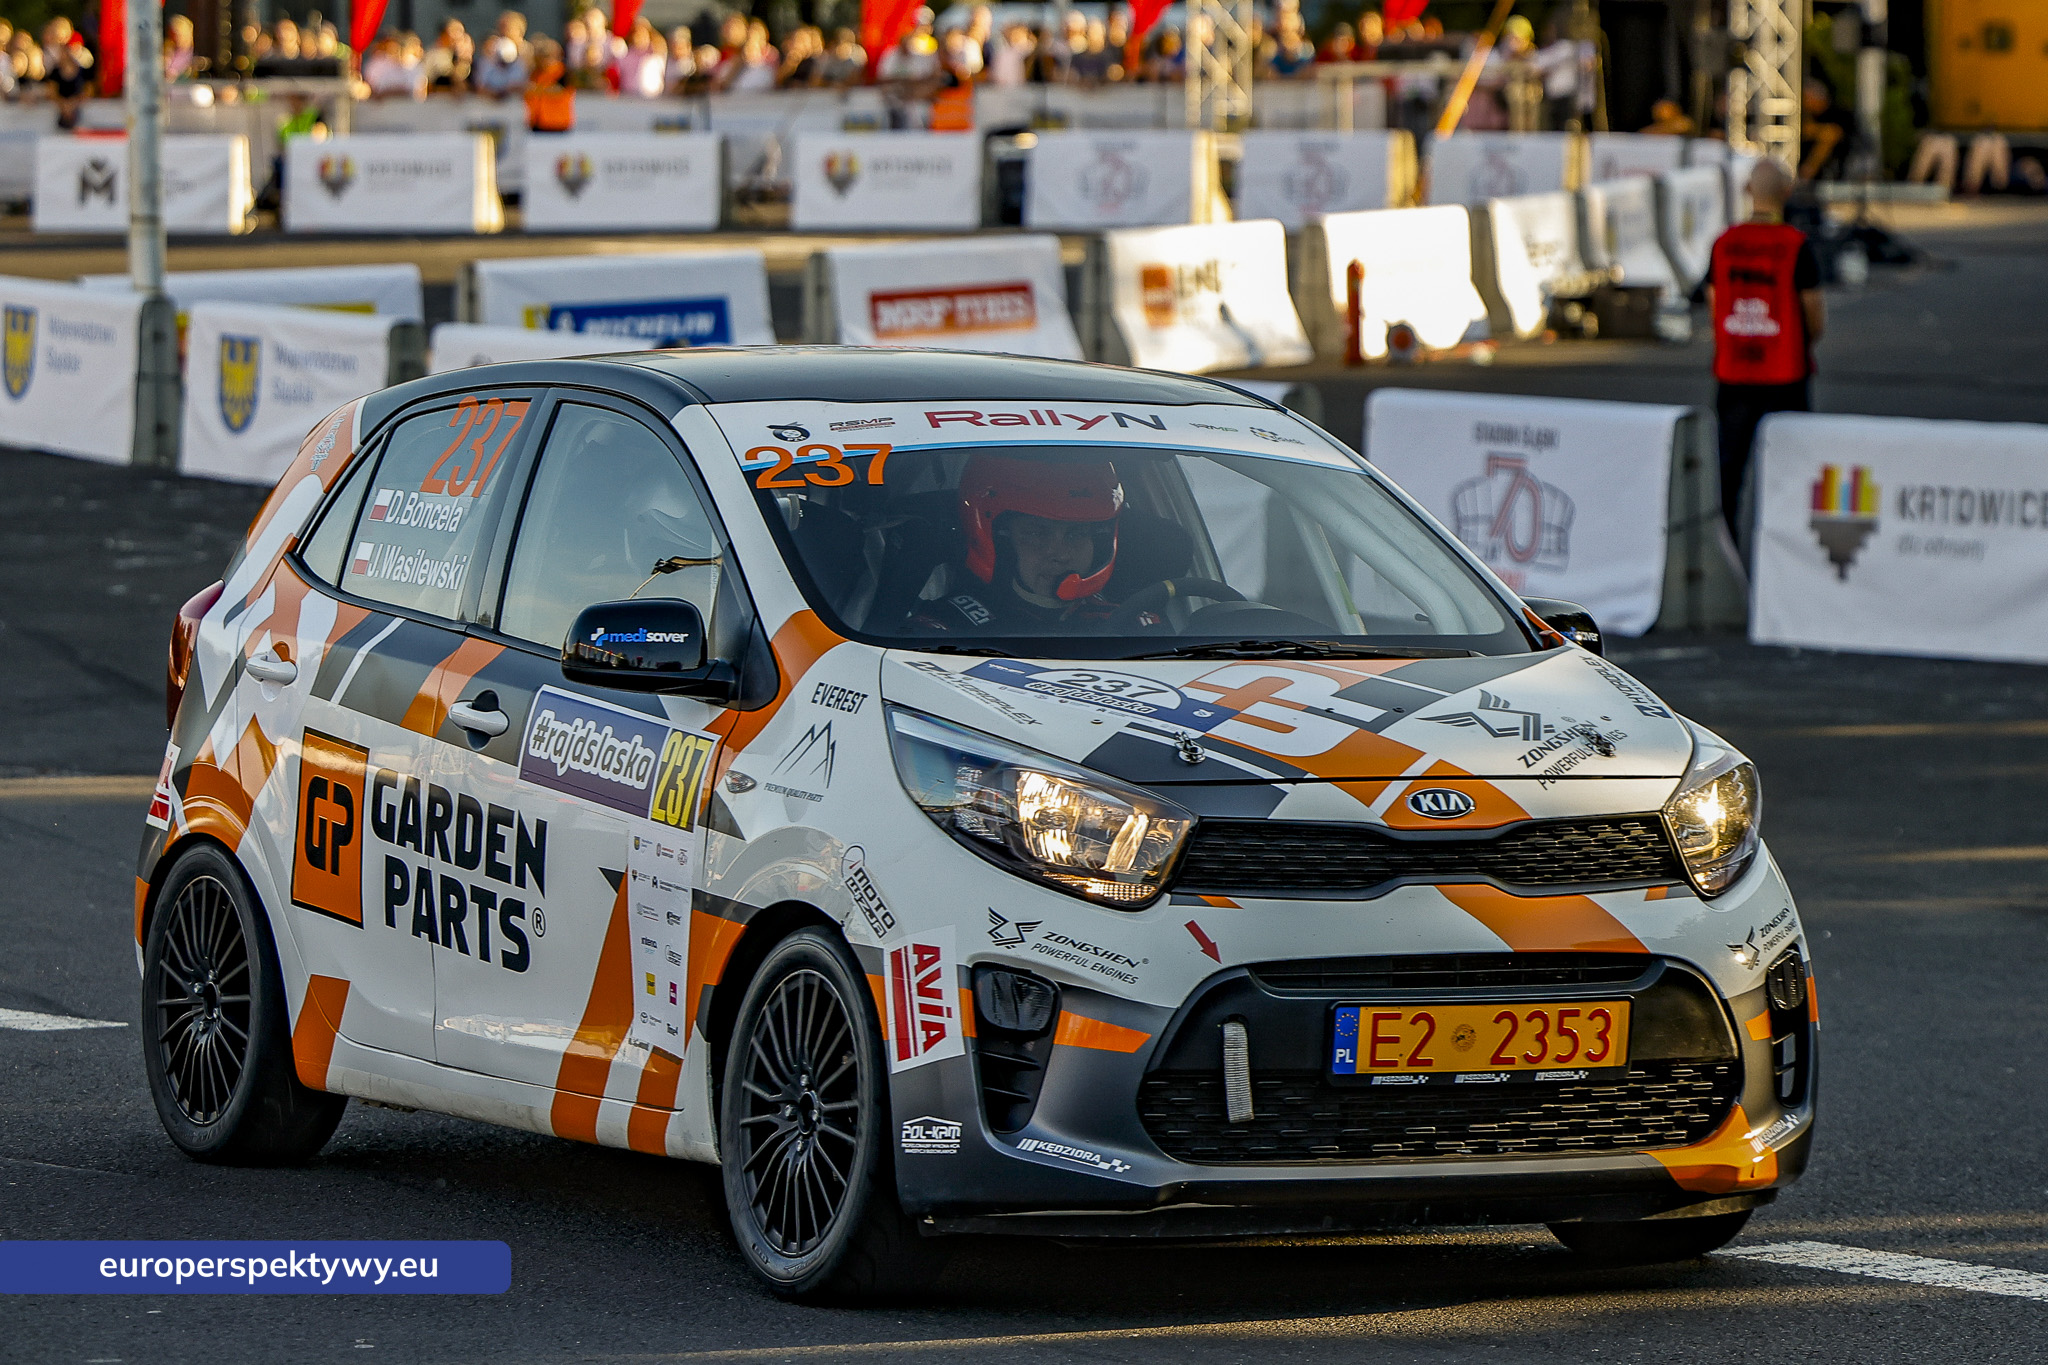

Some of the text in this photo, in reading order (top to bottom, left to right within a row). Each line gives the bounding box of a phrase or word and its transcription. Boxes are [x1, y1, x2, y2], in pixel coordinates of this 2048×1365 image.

[924, 408, 1168, 431] RallyN
[419, 395, 532, 498] 237
[745, 443, 893, 489] 237
[384, 489, 465, 533] D.Boncela
[366, 543, 468, 590] J.Wasilewski
[609, 627, 689, 643] medisaver
[811, 682, 869, 714] EVEREST
[1028, 681, 1156, 714] #rajdslaska
[1057, 673, 1169, 699] 237
[531, 714, 652, 784] #rajdslaska
[1537, 747, 1593, 791] POWERFUL
[651, 731, 714, 829] 237
[1417, 792, 1468, 813] KIA
[305, 774, 355, 877] GP
[371, 767, 549, 900] GARDEN
[853, 867, 897, 931] MOTO
[1031, 942, 1140, 985] POWERFUL ENGINES
[1042, 931, 1142, 969] ZONGSHEN
[1335, 1048, 1354, 1064] PL
[1369, 1006, 1612, 1068] E2 2353
[902, 1125, 961, 1140] POL-KAM
[1036, 1140, 1101, 1163] KĘDZIORA
